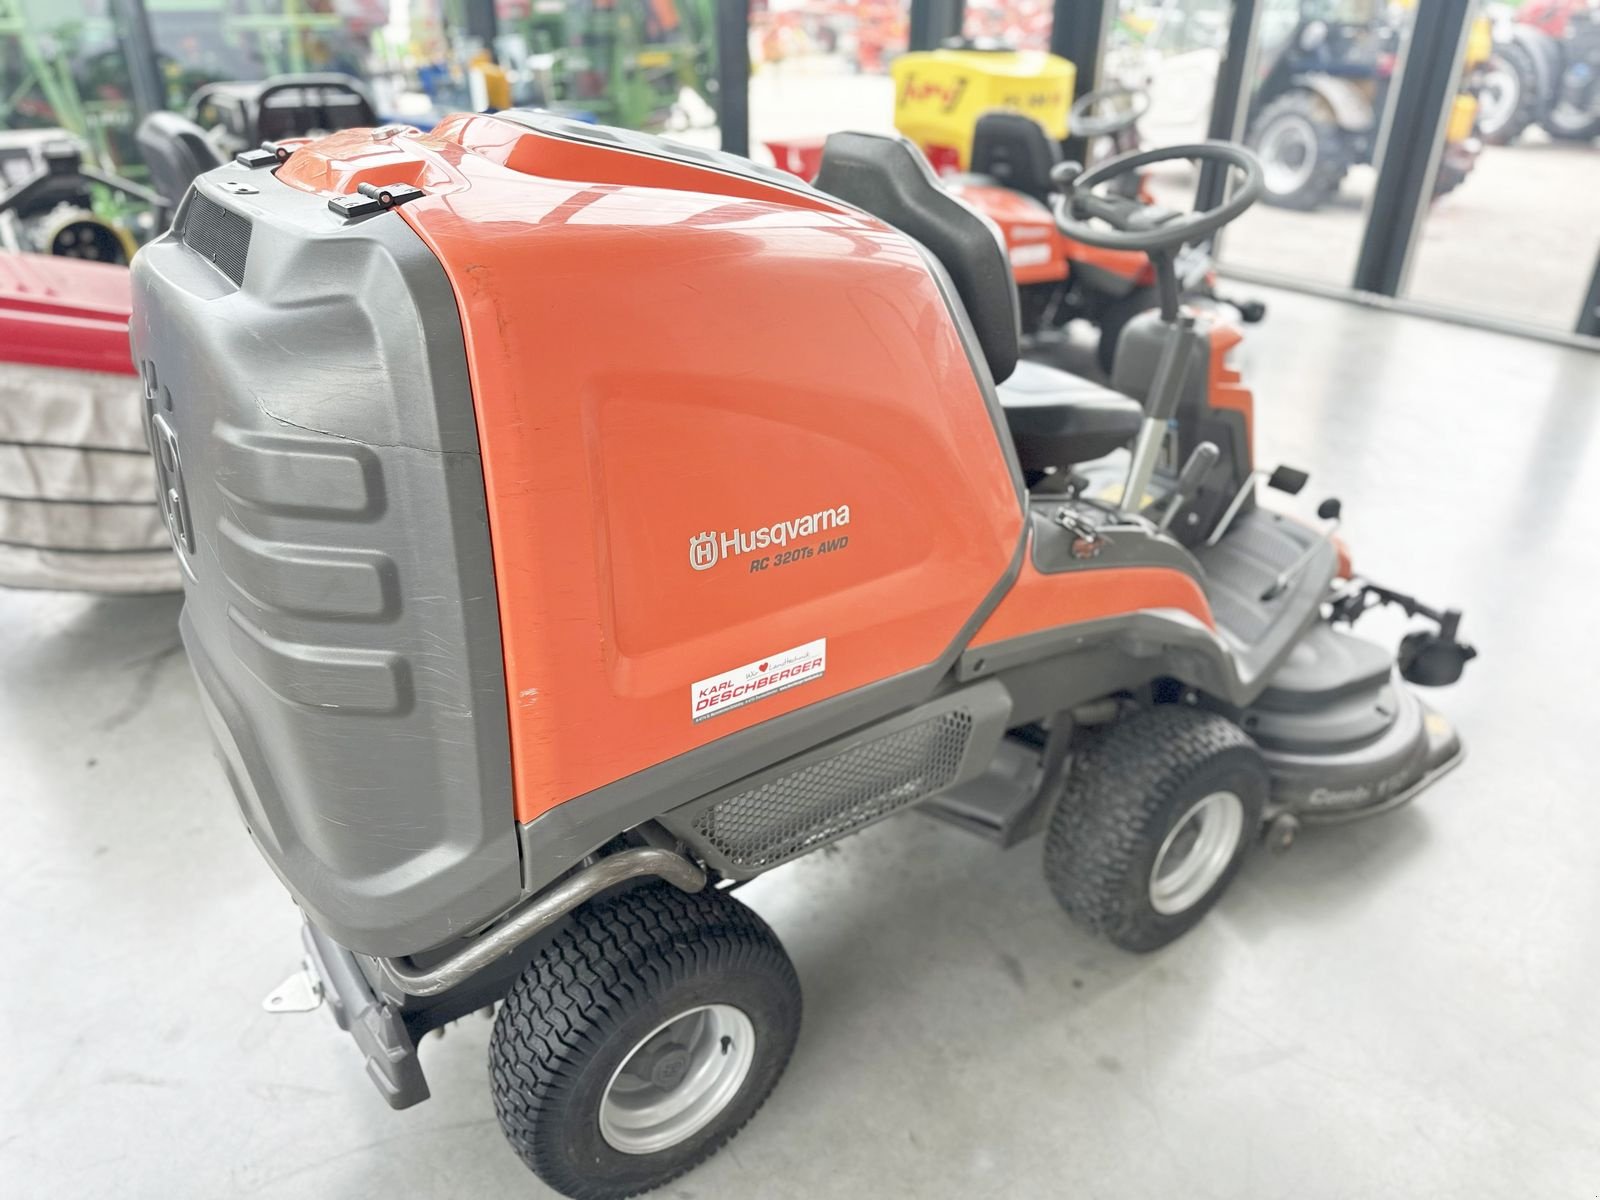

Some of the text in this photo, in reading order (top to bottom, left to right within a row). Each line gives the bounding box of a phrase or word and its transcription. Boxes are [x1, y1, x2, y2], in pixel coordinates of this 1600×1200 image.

[720, 504, 850, 559] Husqvarna
[750, 536, 849, 573] RC 320Ts AWD
[695, 657, 823, 712] DESCHBERGER
[699, 680, 735, 698] KARL
